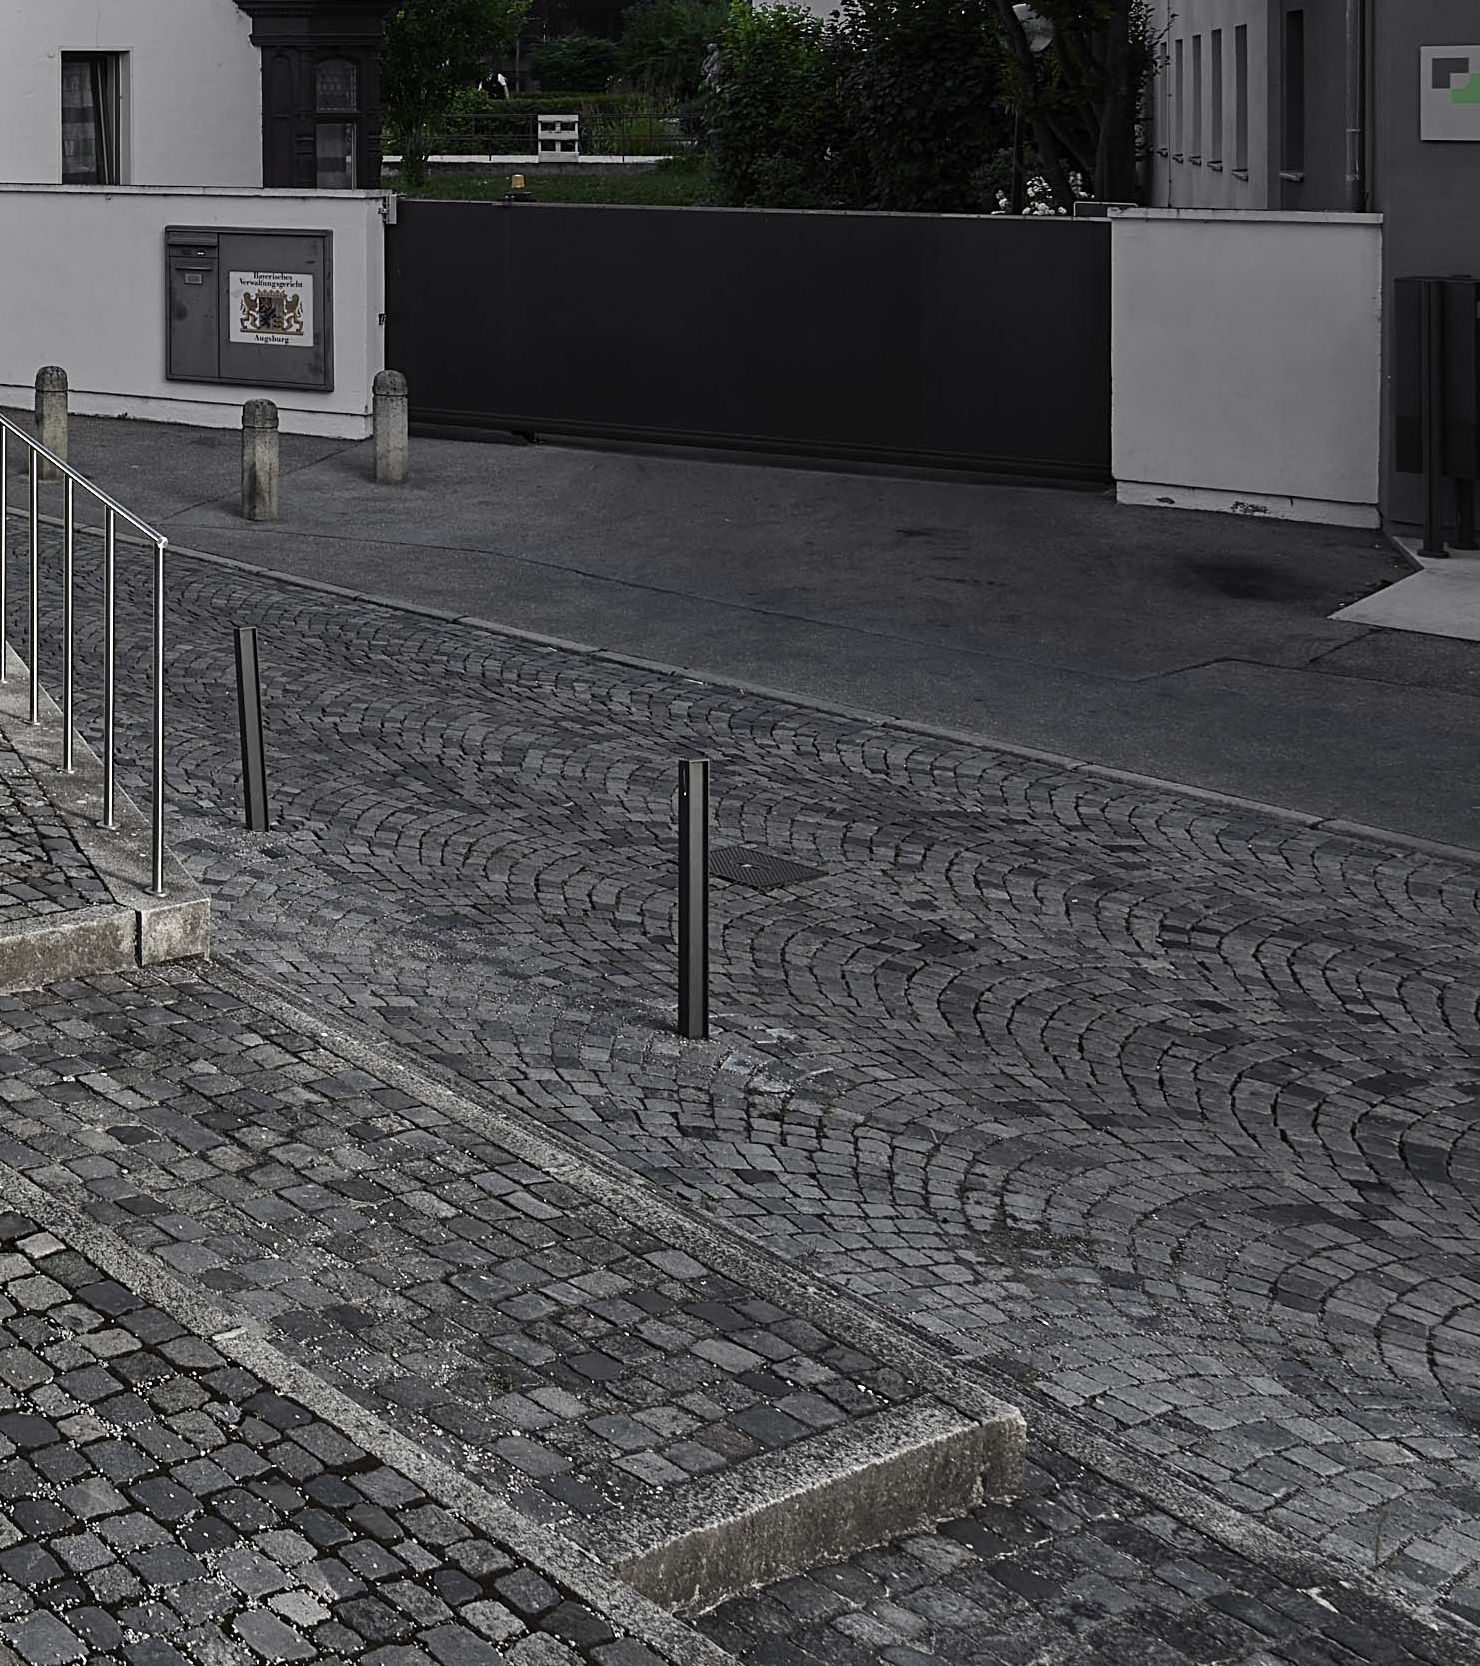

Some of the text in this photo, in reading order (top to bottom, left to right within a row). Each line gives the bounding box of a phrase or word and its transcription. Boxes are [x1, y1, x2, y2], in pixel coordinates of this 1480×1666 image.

[253, 271, 293, 280] Bayerisches
[239, 278, 303, 289] Verwaltungsgericht
[254, 334, 290, 344] Augsburg
